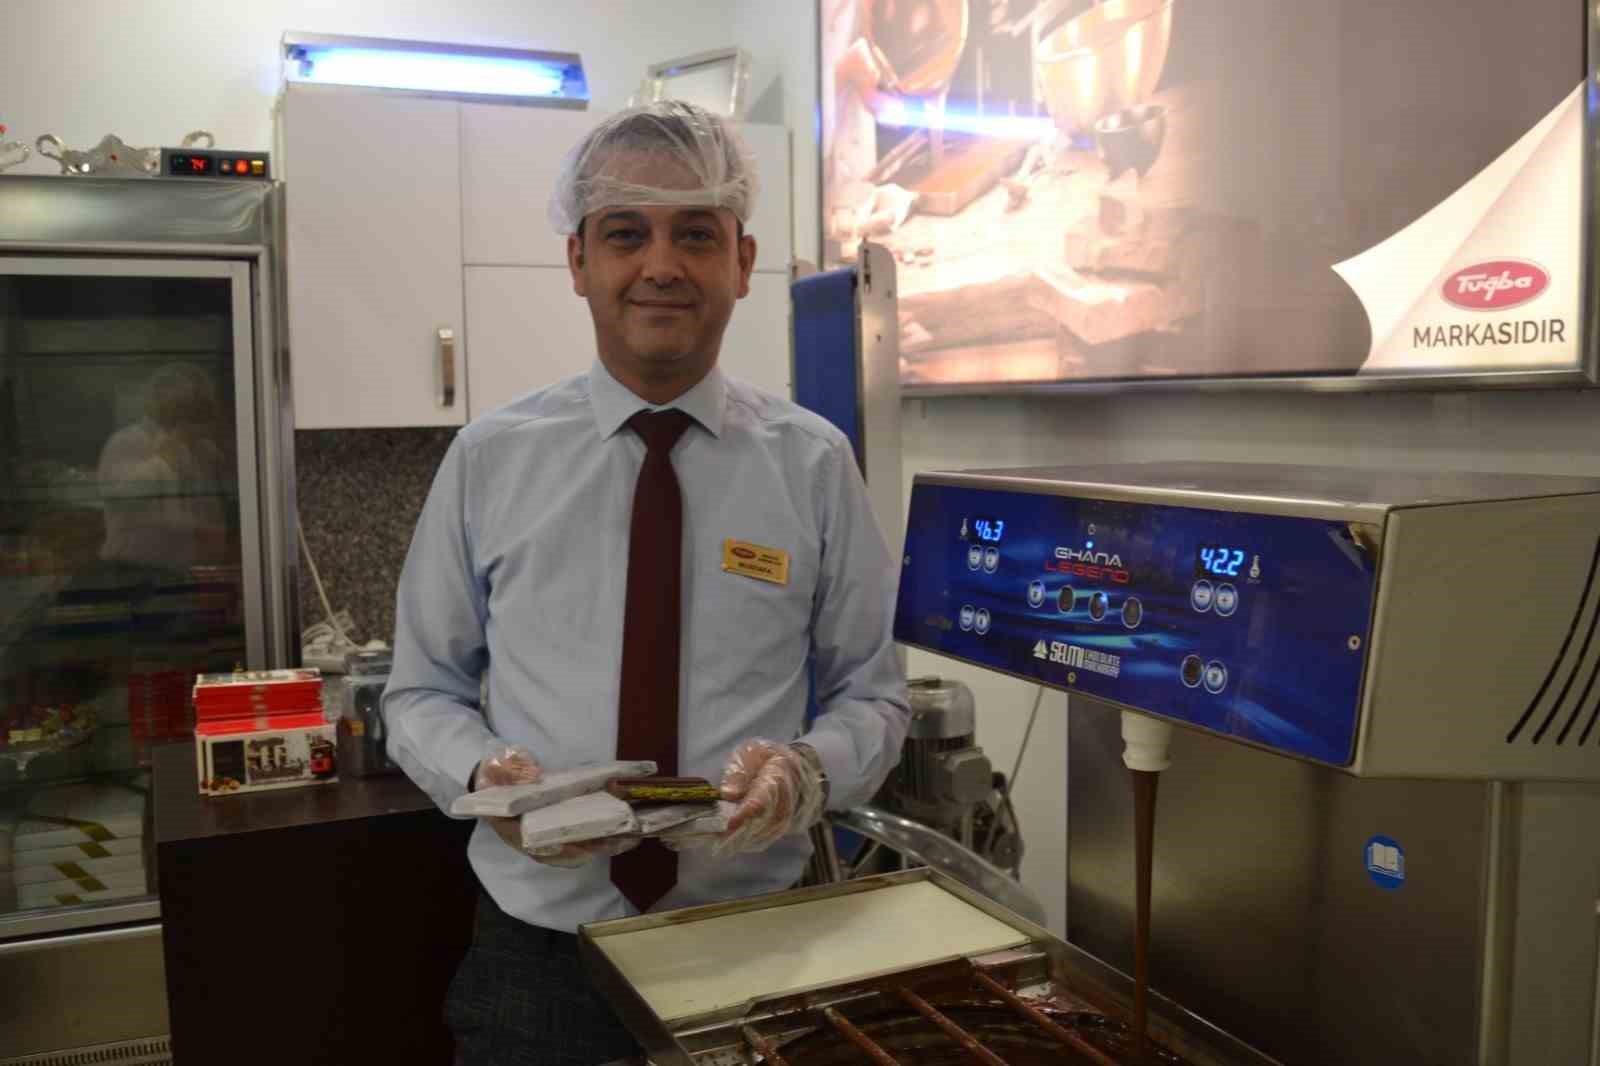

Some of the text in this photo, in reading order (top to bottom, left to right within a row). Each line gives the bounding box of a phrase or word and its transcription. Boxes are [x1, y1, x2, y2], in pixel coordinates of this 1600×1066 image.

[1413, 318, 1565, 348] MARKASIDIR
[1055, 546, 1122, 567] GHANA
[1200, 548, 1244, 576] 42.2
[1045, 560, 1129, 583] LEGEND
